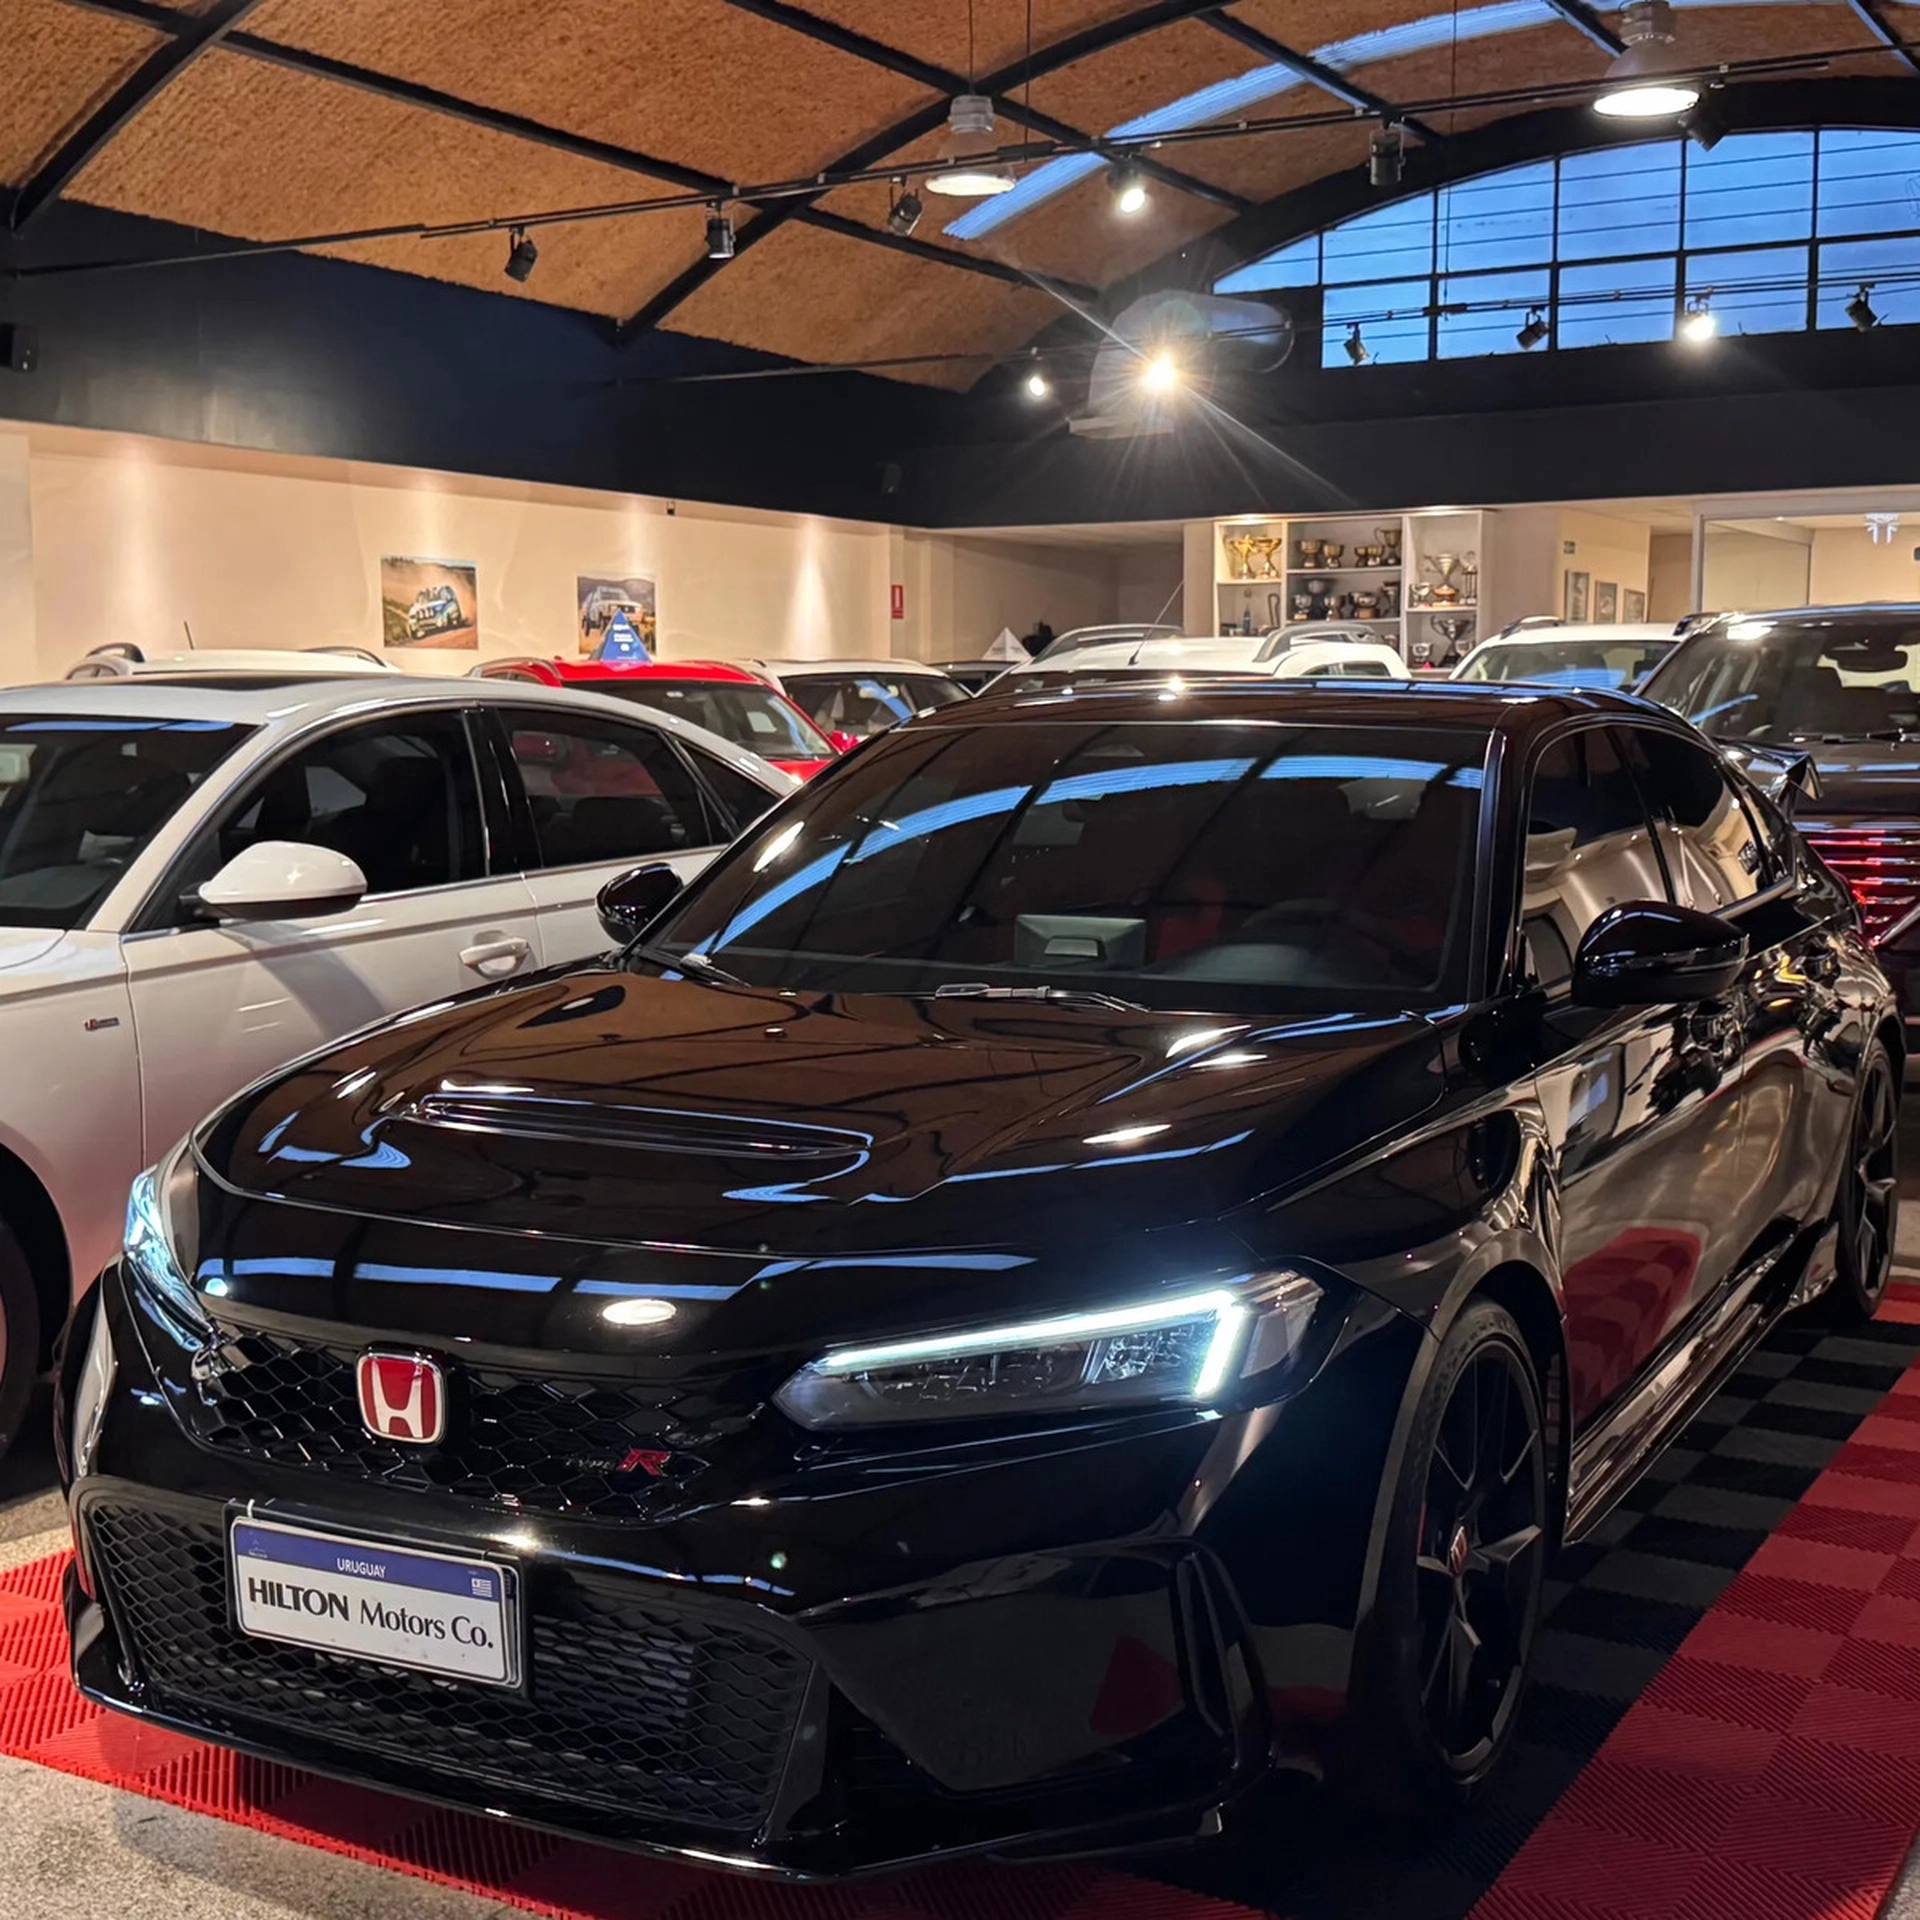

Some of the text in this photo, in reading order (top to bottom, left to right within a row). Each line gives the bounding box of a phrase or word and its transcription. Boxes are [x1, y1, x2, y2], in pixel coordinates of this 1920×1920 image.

[615, 1448, 672, 1477] R
[336, 1558, 387, 1578] URUGUAY
[248, 1577, 494, 1649] HILTON Motors Co.
